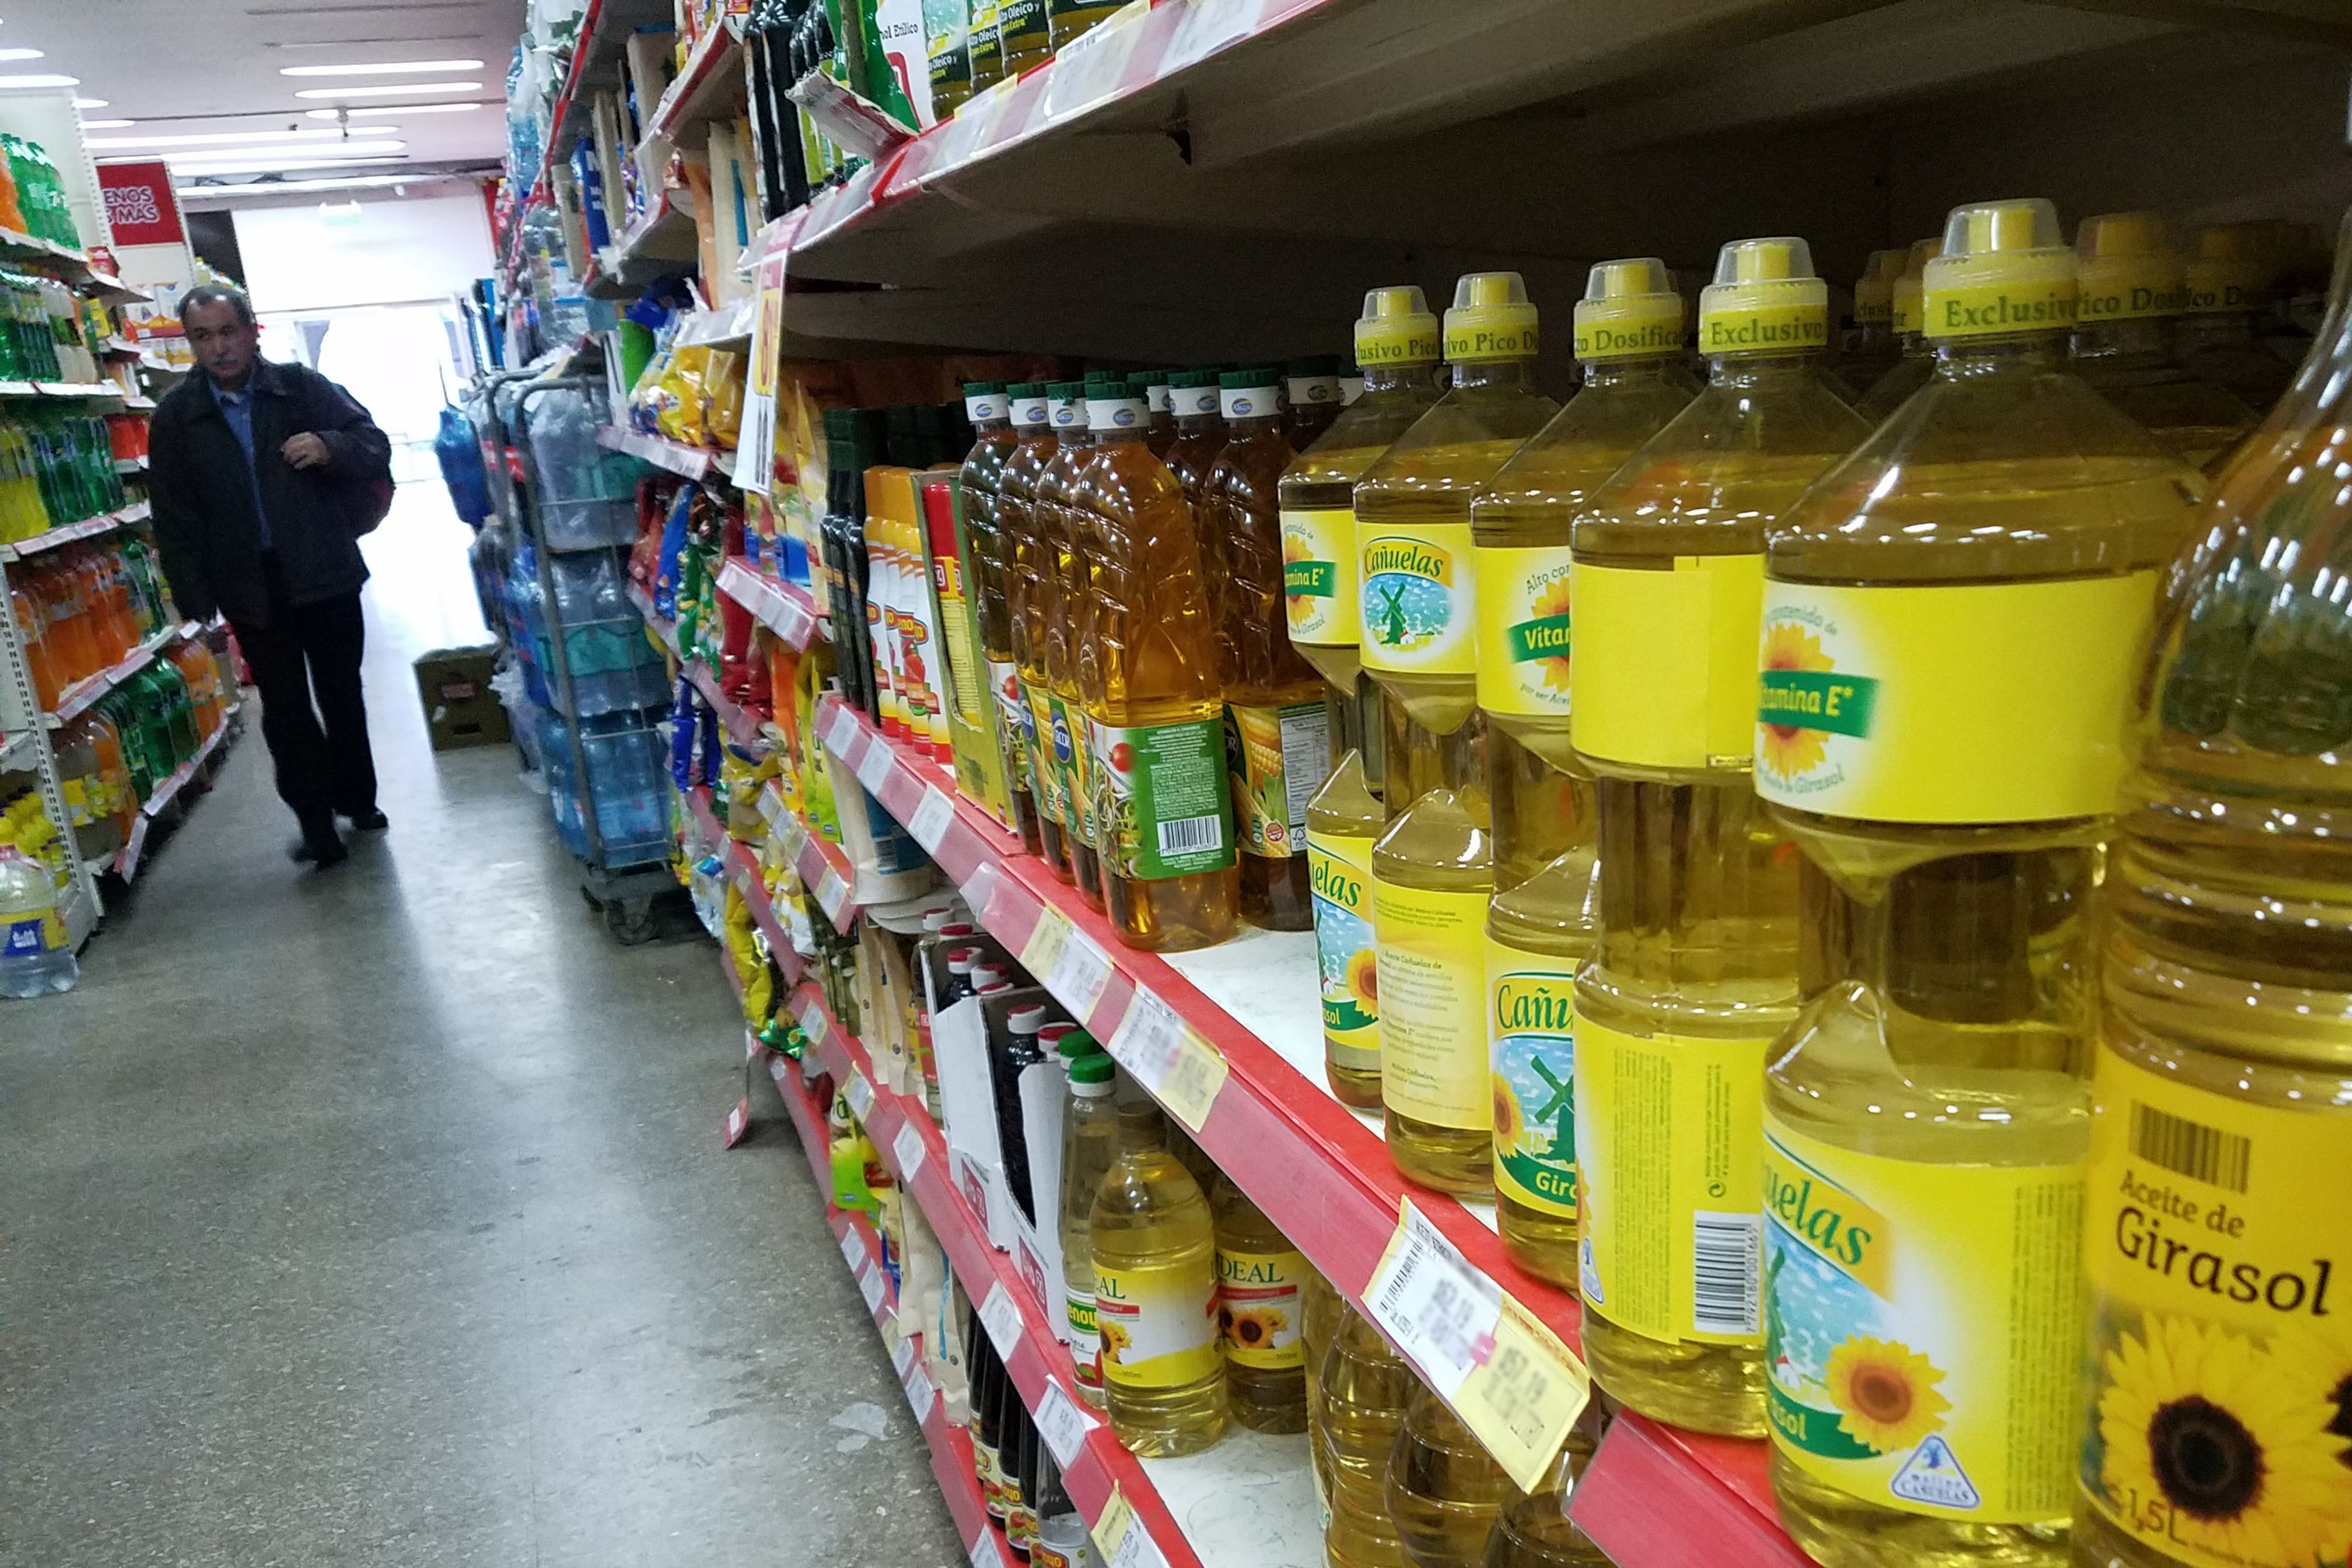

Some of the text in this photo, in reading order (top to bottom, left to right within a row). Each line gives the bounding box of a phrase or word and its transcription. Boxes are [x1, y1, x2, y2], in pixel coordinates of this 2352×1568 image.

[1007, 2, 1034, 20] Oleico
[1476, 332, 1517, 352] Pico
[1364, 545, 1444, 577] Cañuelas
[1526, 573, 1549, 595] Alto
[1433, 961, 1442, 970] de
[2119, 1169, 2246, 1238] Aceite de
[2116, 1205, 2333, 1317] Girasol
[1096, 1276, 1126, 1300] AL
